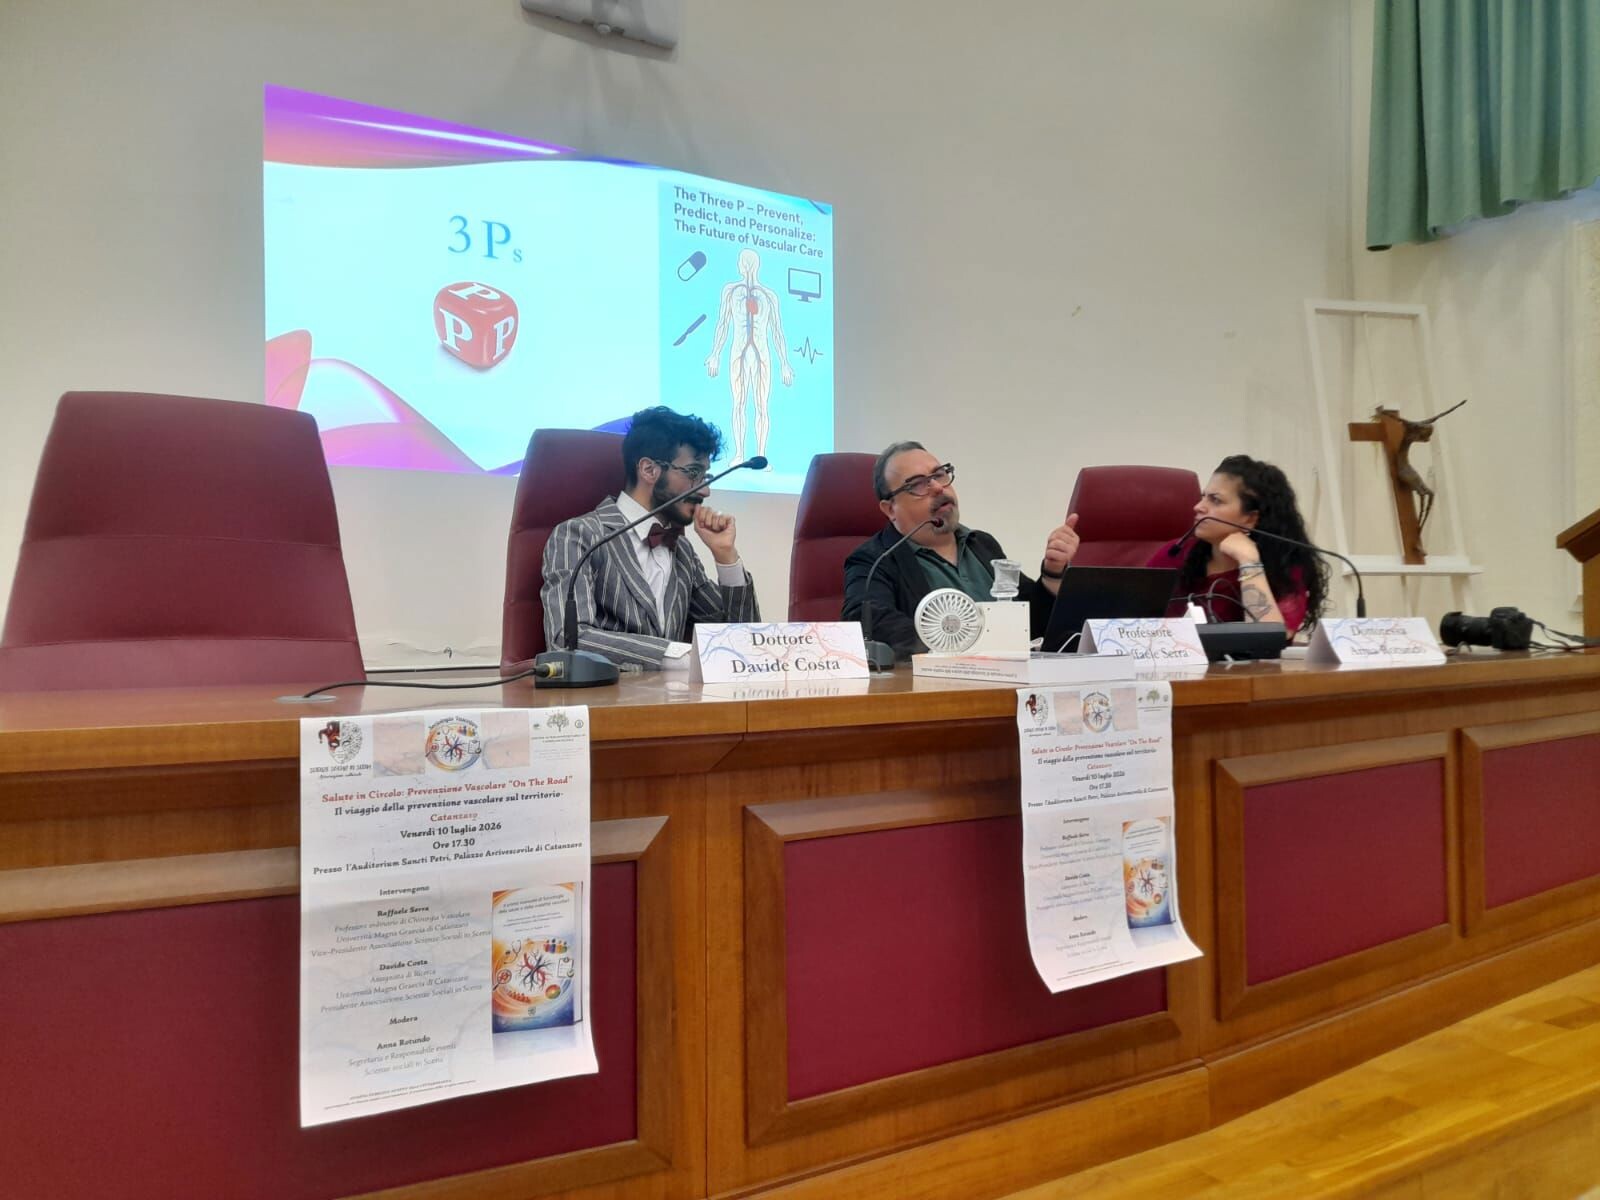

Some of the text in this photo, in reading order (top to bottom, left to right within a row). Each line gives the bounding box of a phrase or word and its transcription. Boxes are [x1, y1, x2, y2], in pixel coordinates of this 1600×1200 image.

[674, 186, 696, 201] The
[699, 192, 733, 209] Three
[737, 200, 744, 211] P
[757, 204, 804, 225] Prevent,
[674, 204, 816, 242] Predict, and Personalize:
[448, 215, 471, 253] 3
[674, 219, 823, 257] The Future of Vascular Care
[448, 283, 501, 300] P
[439, 308, 472, 352] P
[493, 316, 514, 360] P
[751, 632, 813, 647] Dottore
[1118, 627, 1173, 638] Professore
[1161, 648, 1188, 658] Serra
[732, 657, 840, 674] Davide Costa
[322, 791, 354, 802] Salute
[356, 790, 366, 800] in
[369, 788, 404, 798] Circolo:
[408, 785, 462, 796] Prevenzione
[465, 780, 506, 792] Vascolare
[529, 778, 544, 788] The
[334, 806, 342, 816] Il
[344, 804, 379, 816] viaggio
[382, 802, 404, 812] della
[407, 798, 460, 812] prevenzione
[464, 795, 503, 805] vascolare
[506, 792, 518, 801] sul
[430, 812, 478, 822] Catanzaro
[438, 826, 448, 835] 10
[450, 824, 476, 836] luglio
[479, 822, 502, 831] 2026
[433, 838, 475, 850] Ore 17.30
[313, 842, 582, 875] Presso l'Auditorium Sancti Petri, Palazzo Arcivescovile di Catanzaro
[380, 884, 429, 896] Intervengono
[377, 908, 408, 917] Raffaele
[374, 931, 397, 939] Magna
[379, 962, 405, 971] Davide
[374, 986, 396, 994] Magna
[390, 1016, 418, 1025] Modera
[377, 1036, 431, 1050] Anna Rotundo
